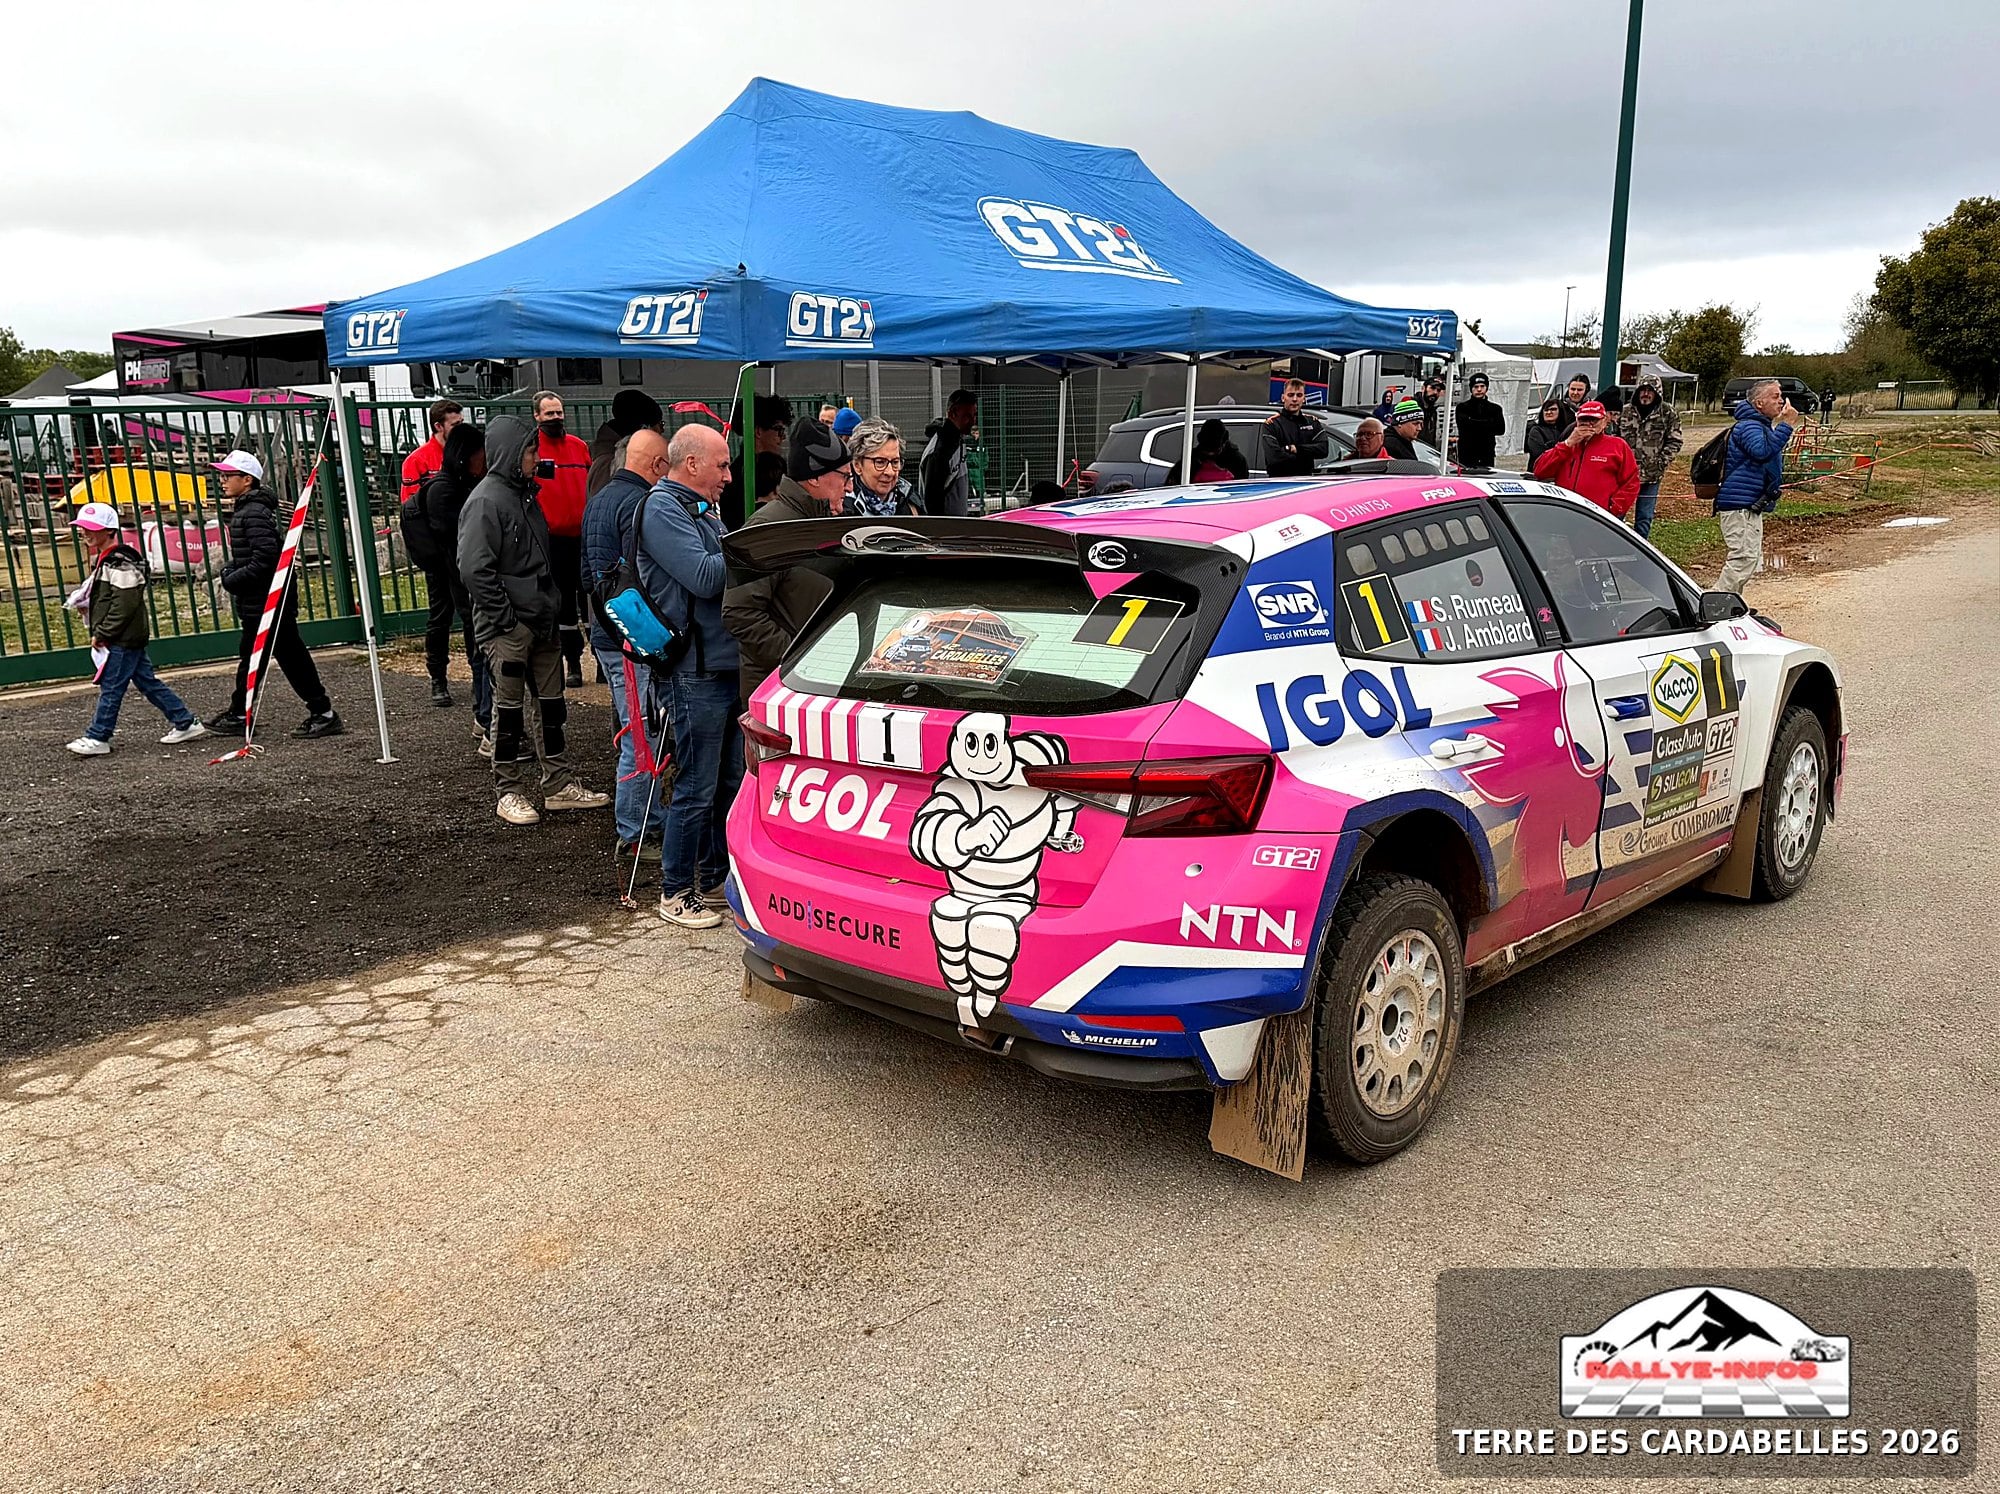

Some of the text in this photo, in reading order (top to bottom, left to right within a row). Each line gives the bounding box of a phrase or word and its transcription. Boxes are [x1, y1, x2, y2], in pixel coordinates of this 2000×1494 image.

[979, 198, 1168, 277] GT2i
[347, 309, 406, 347] GT2i
[619, 289, 709, 338] GT2i
[786, 291, 875, 339] GT2i
[1348, 498, 1392, 518] HINTSA
[1278, 525, 1300, 538] ETS
[1105, 598, 1149, 646] 1
[1256, 592, 1318, 616] SNR
[1358, 582, 1391, 644] 1
[1430, 594, 1524, 622] S. Rumeau
[1264, 628, 1330, 641] Brand of NTN Group
[1445, 615, 1535, 652] J. Amblard
[930, 650, 1008, 666] CARDABELLES
[1659, 676, 1694, 701] YACCO
[1709, 648, 1727, 710] 1
[1256, 666, 1433, 754] IGOL
[882, 712, 896, 763] 1
[1656, 728, 1703, 759] ClassAuto
[1706, 716, 1739, 753] GT2i
[1663, 766, 1699, 793] SILIGOM
[768, 764, 898, 840] IGOL
[1640, 804, 1735, 853] Groupe COMBRONDE
[1253, 846, 1321, 870] GT2i
[813, 908, 901, 949] SECURE
[1179, 902, 1297, 950] NTN
[1084, 1034, 1158, 1046] MICHELIN
